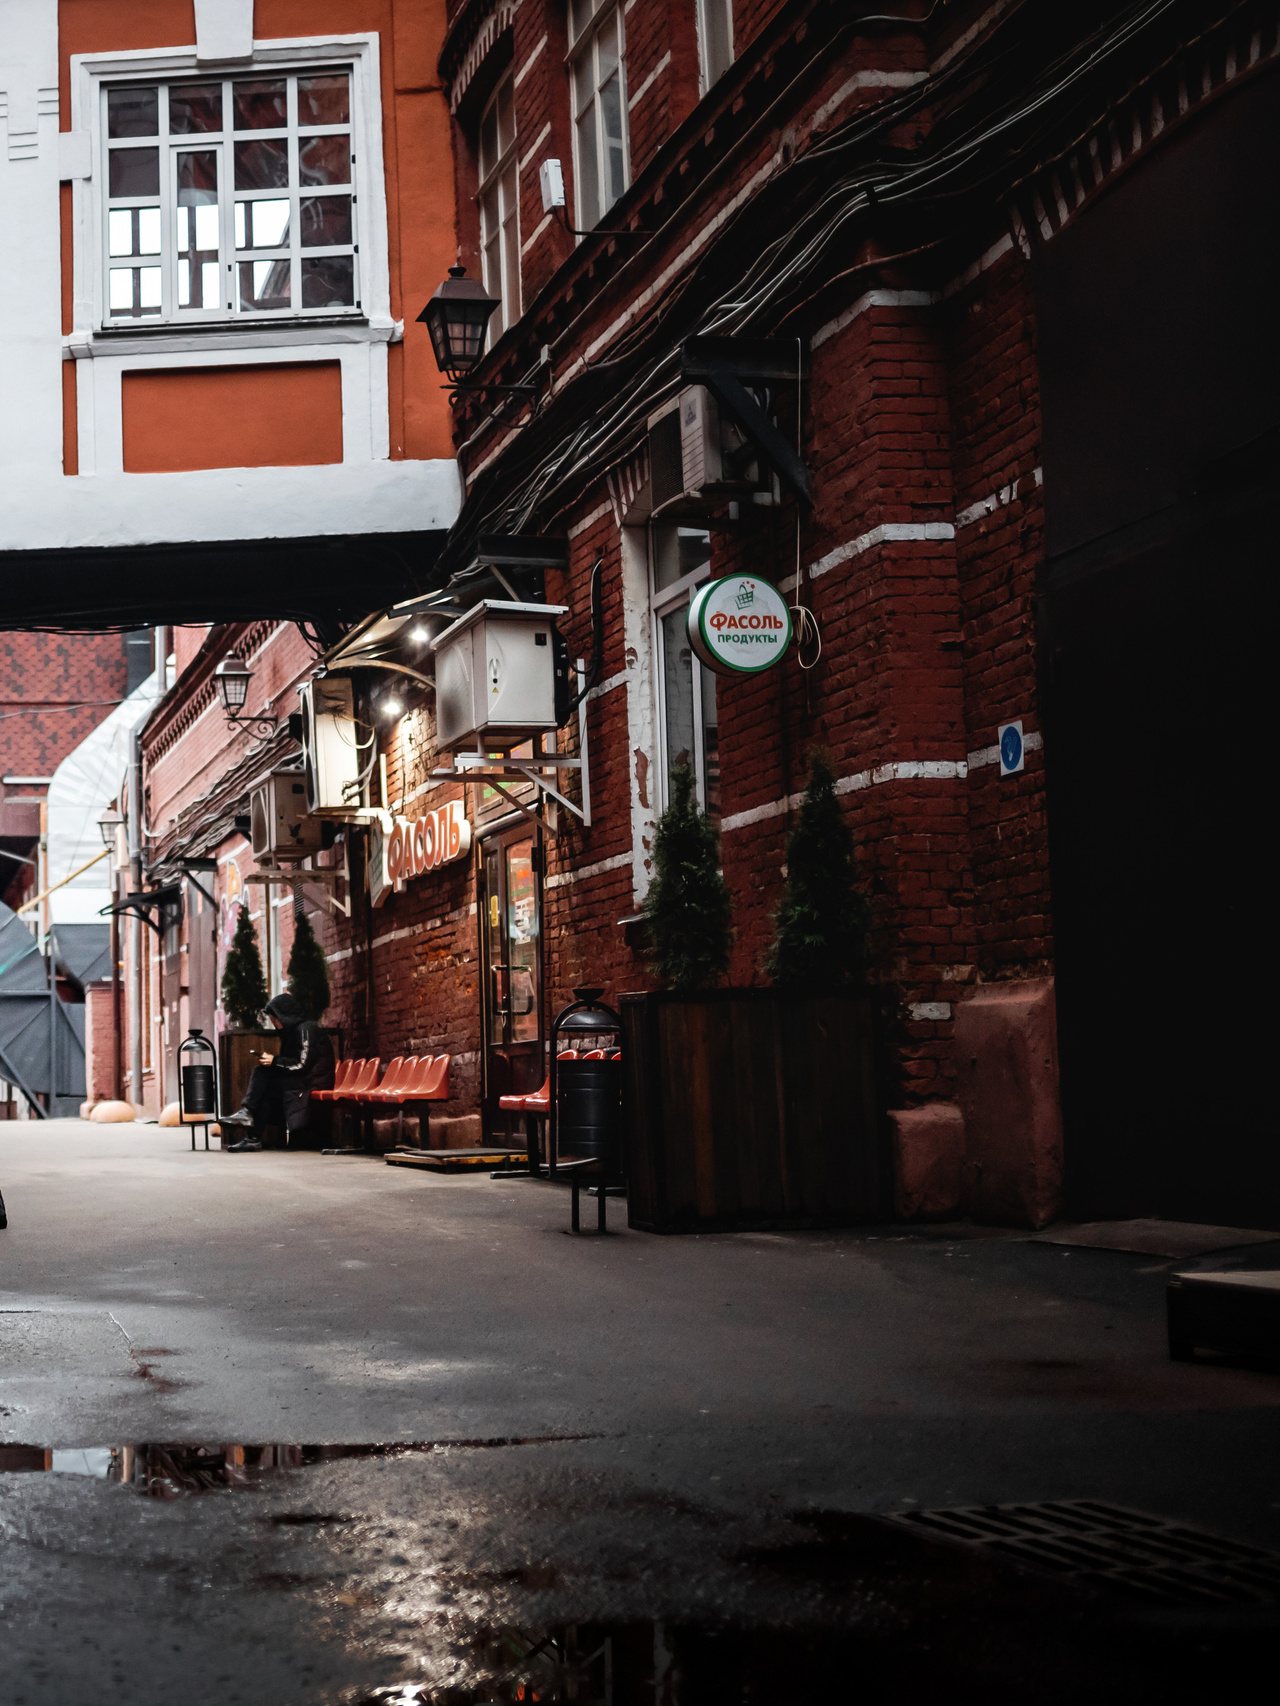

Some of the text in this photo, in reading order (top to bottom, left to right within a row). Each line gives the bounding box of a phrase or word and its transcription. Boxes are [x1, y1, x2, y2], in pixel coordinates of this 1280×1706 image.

[709, 611, 784, 631] ФАСОЛЬ
[717, 634, 778, 645] ПРОДУКТЫ
[387, 803, 461, 893] ФАСОЛЬ
